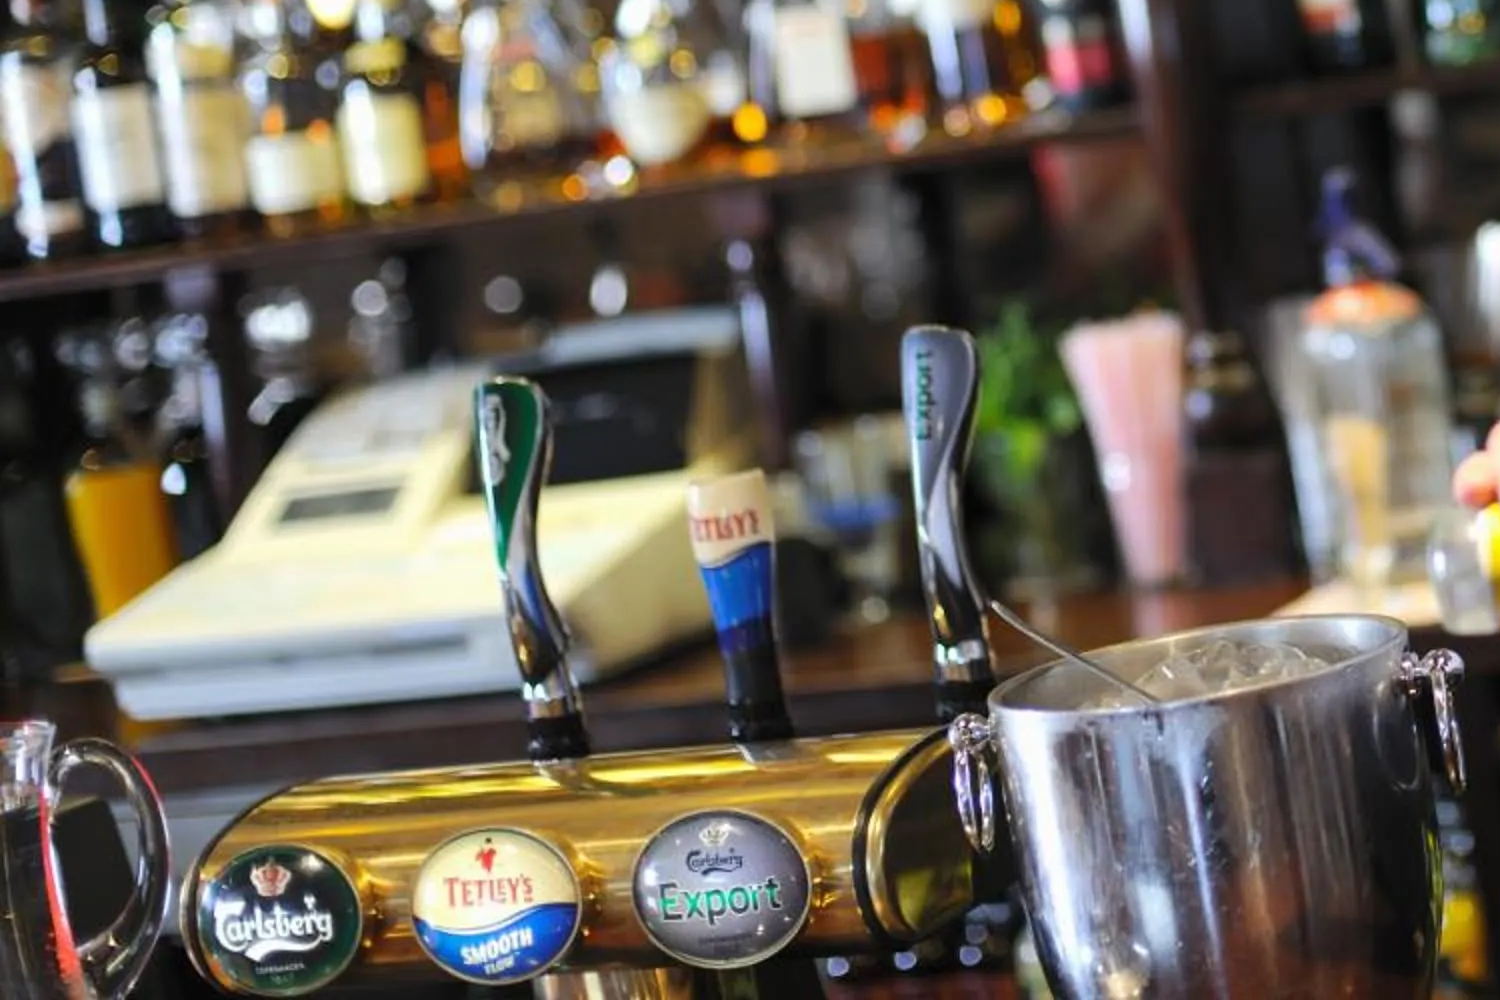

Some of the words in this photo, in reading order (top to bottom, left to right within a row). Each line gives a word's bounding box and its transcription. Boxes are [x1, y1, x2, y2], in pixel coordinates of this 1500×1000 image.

[916, 351, 935, 439] Export
[686, 848, 743, 875] Carlsberg
[443, 874, 534, 908] TETLEY'S
[659, 877, 782, 925] Export
[214, 893, 333, 962] Carlsberg
[460, 926, 534, 966] SMOOTH
